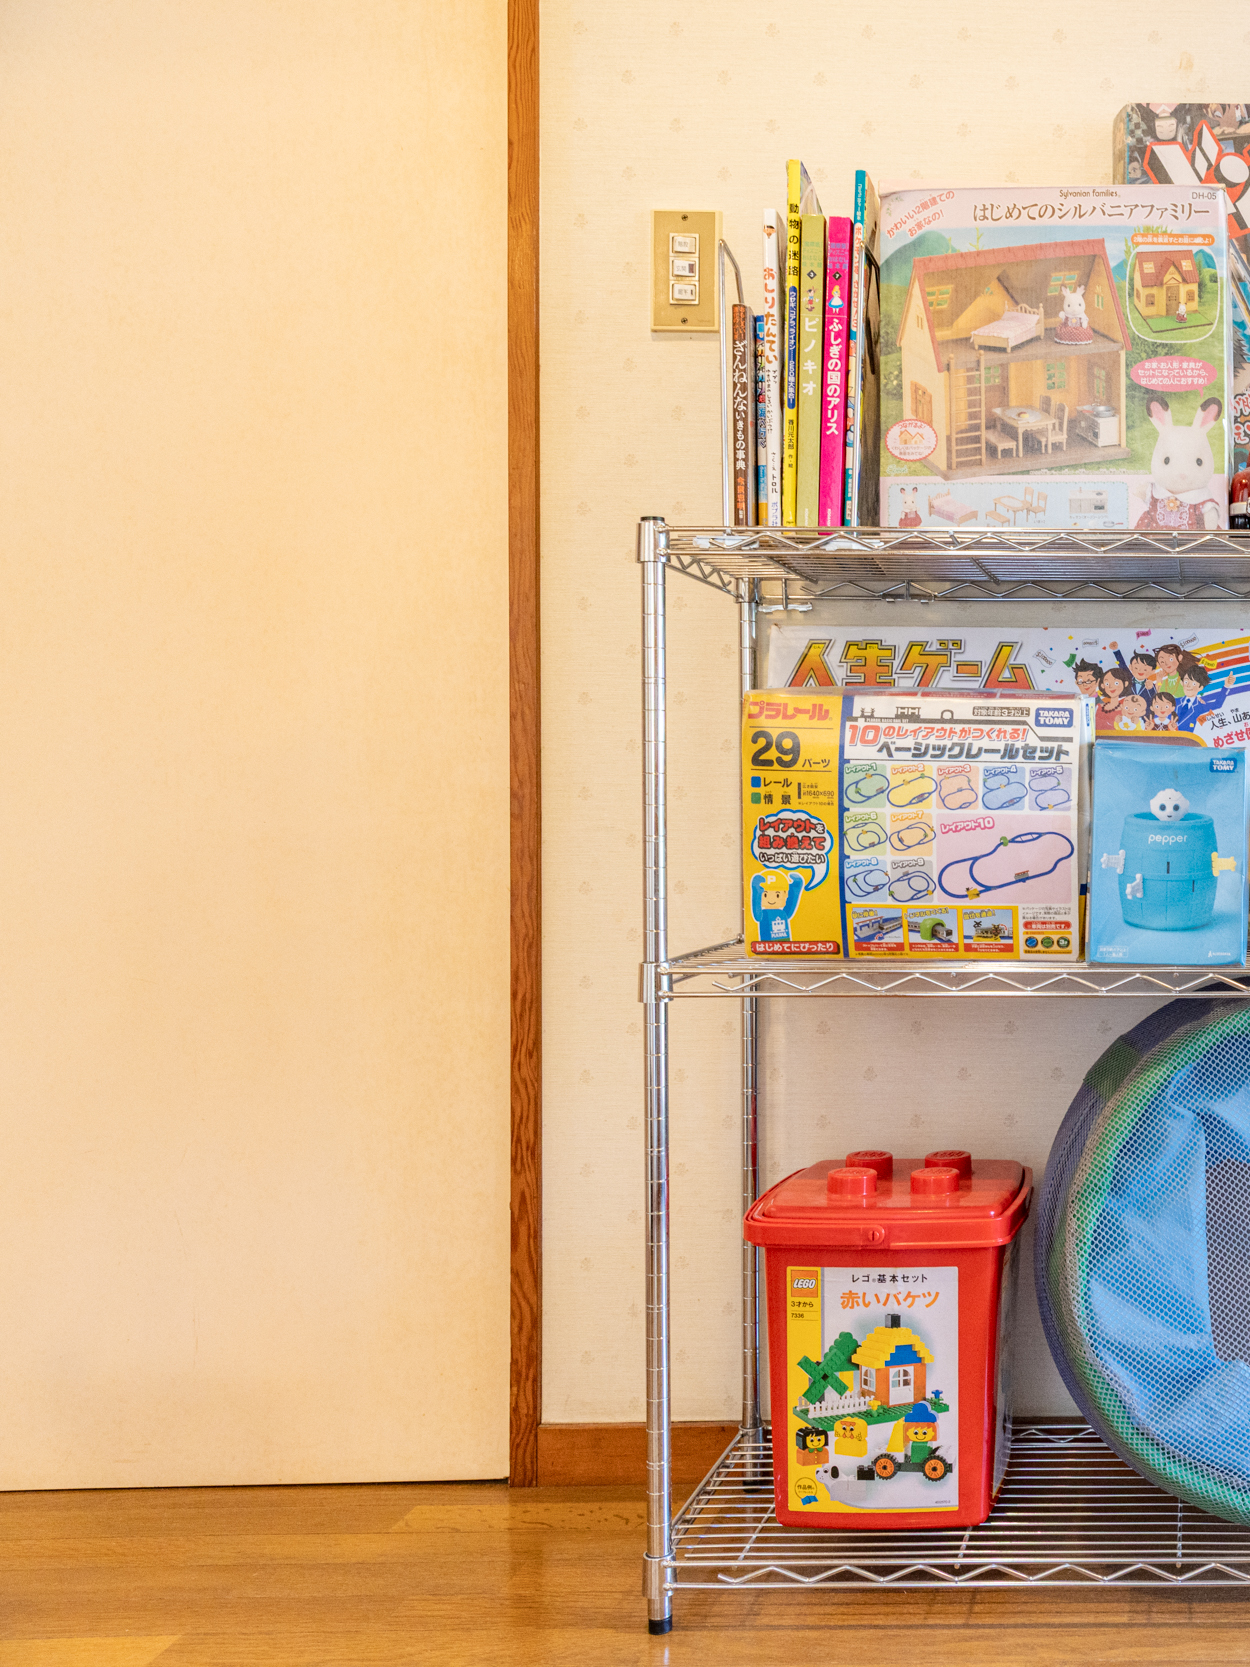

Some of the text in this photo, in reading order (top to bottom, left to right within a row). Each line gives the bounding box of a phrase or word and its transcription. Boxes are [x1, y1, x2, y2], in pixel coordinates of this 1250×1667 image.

[1059, 189, 1091, 199] Sylvanian
[1191, 192, 1217, 200] DH-05
[886, 191, 955, 239] かわいい2階建ての
[973, 202, 1210, 222] はじめてのシルバニアファミリー
[907, 209, 944, 237] お家なの!
[789, 203, 799, 276] 動物の迷路
[764, 267, 778, 364] おしりたんてい
[802, 317, 819, 396] ピノキオ
[825, 318, 843, 435] ふしぎの国のアリス
[733, 340, 747, 470] ざんねんないきもの事典
[786, 639, 1036, 688] 人生ゲーム
[748, 700, 830, 721] プラレール
[1038, 710, 1070, 718] TAKARA
[1038, 717, 1070, 725] TOMY
[849, 724, 1028, 746] 10のレイアウトがつくれる!
[751, 730, 801, 768] 29
[876, 741, 1070, 761] ベーシックレールセット
[845, 763, 877, 773] レイアウト1
[891, 763, 925, 775] レイアウト2
[938, 764, 971, 775] レイアウト3
[984, 765, 1017, 776] レイアウト4
[1030, 766, 1063, 777] レイアウト5
[763, 777, 793, 788] レール
[845, 812, 878, 823] レイアウト6
[891, 810, 924, 822] レイアウト7
[759, 818, 825, 834] レイアウトを
[940, 816, 995, 834] レイアウト10
[758, 835, 826, 849] 組み換えて
[1148, 834, 1188, 846] pepper
[759, 852, 826, 864] いっぱい遊びたい
[845, 857, 879, 868] レイアウト8
[891, 858, 925, 869] レイアウト9
[767, 875, 776, 884] P
[756, 943, 834, 952] はじめてにぴったり
[793, 1279, 816, 1289] LEGO
[840, 1290, 940, 1309] 赤いバケツ
